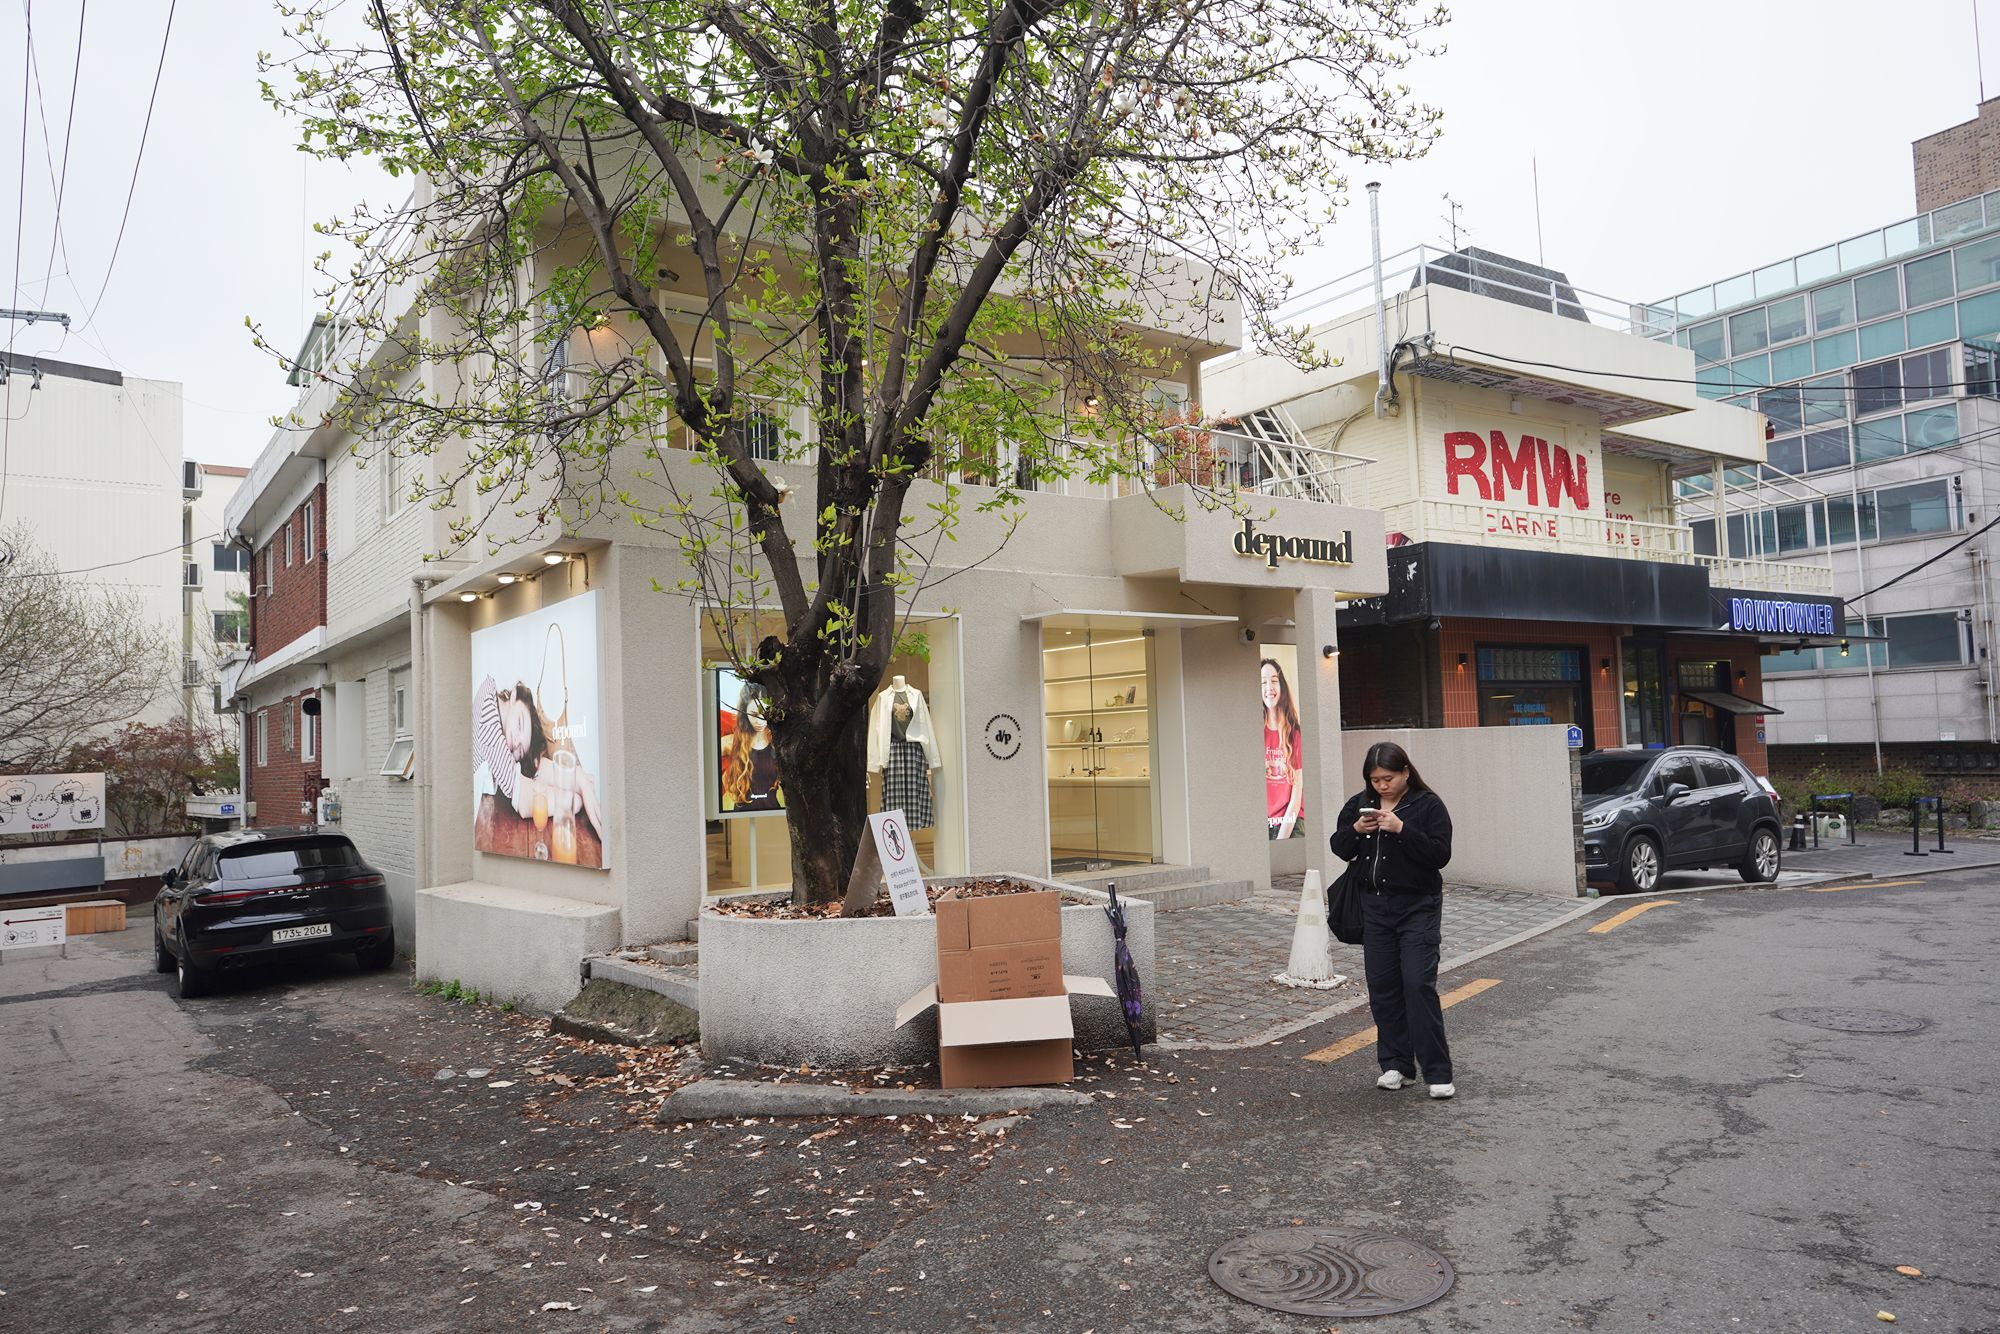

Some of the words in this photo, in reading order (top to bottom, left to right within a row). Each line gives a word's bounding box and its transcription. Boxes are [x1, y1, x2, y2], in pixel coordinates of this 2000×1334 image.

[1443, 430, 1590, 510] RMW
[1233, 518, 1354, 568] depound
[1732, 597, 1834, 635] DOWNTOWNER
[552, 715, 587, 746] depound
[303, 925, 328, 936] 2064
